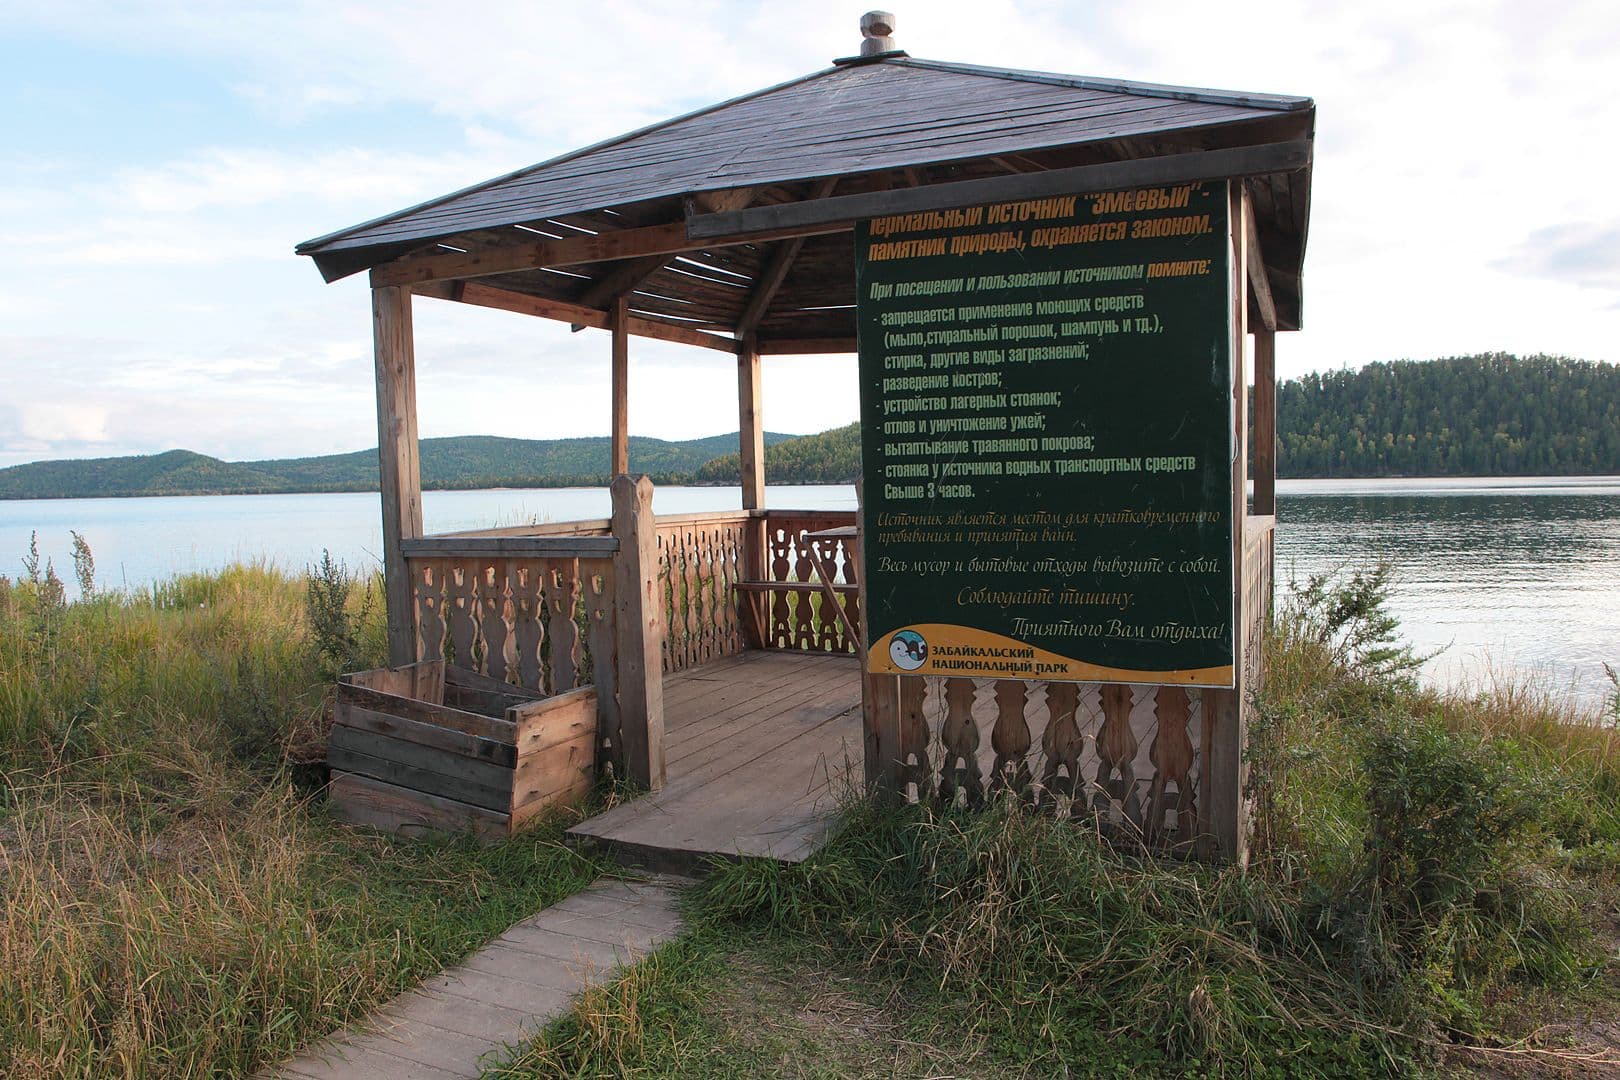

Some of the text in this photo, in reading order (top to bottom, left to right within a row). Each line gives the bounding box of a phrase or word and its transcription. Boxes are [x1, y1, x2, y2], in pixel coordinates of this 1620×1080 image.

[987, 195, 1076, 225] источник
[868, 214, 1213, 262] памятник природы, охраняется законом.
[869, 282, 893, 301] При
[895, 278, 964, 297] посещении
[966, 280, 976, 292] и
[1063, 264, 1145, 285] источником
[1146, 259, 1212, 279] помните:
[881, 307, 956, 327] запрещается
[958, 301, 1033, 323] применение
[1036, 297, 1092, 315] моющих
[1094, 294, 1144, 313] средств
[884, 324, 999, 349] (мыло,стиральный
[1001, 322, 1058, 342] порошок,
[1061, 319, 1119, 336] шампунь
[1122, 318, 1132, 333] и
[884, 341, 1090, 370] стирка, другие виды загрязнений;
[883, 374, 949, 394] разведение
[952, 371, 1003, 389] костров;
[883, 394, 948, 416] устройство
[950, 393, 1007, 411] лагерных
[1010, 391, 1062, 408] стоянок;
[884, 419, 916, 434] отлов
[918, 420, 927, 433] и
[929, 416, 1007, 435] уничтожение
[1010, 412, 1046, 432] ужей;
[884, 440, 969, 456] вытаптывание
[972, 437, 1038, 455] травянного
[1041, 435, 1095, 453] покрова;
[885, 463, 929, 478] стоянка
[932, 463, 939, 478] у
[942, 460, 1002, 477] источника
[1005, 459, 1051, 476] водных
[1054, 457, 1142, 476] транспортных
[1145, 455, 1196, 474] средств
[884, 482, 976, 500] Свыше 3 часов.
[877, 507, 1221, 528] Источник является местом для кратковременного
[878, 527, 1078, 547] пребывания и принятия ванн.
[877, 556, 1222, 578] Весь мусор и бытовые отходы вывозите с собой.
[956, 586, 1136, 611] Соблюдайте тишину.
[1011, 617, 1226, 644] Приятного Вам отдыха!
[931, 645, 1035, 659] ЗАБАЙКАЛЬСКИЙ
[931, 659, 1070, 674] НАЦИОНАЛЬНЫЙ ПАРК
